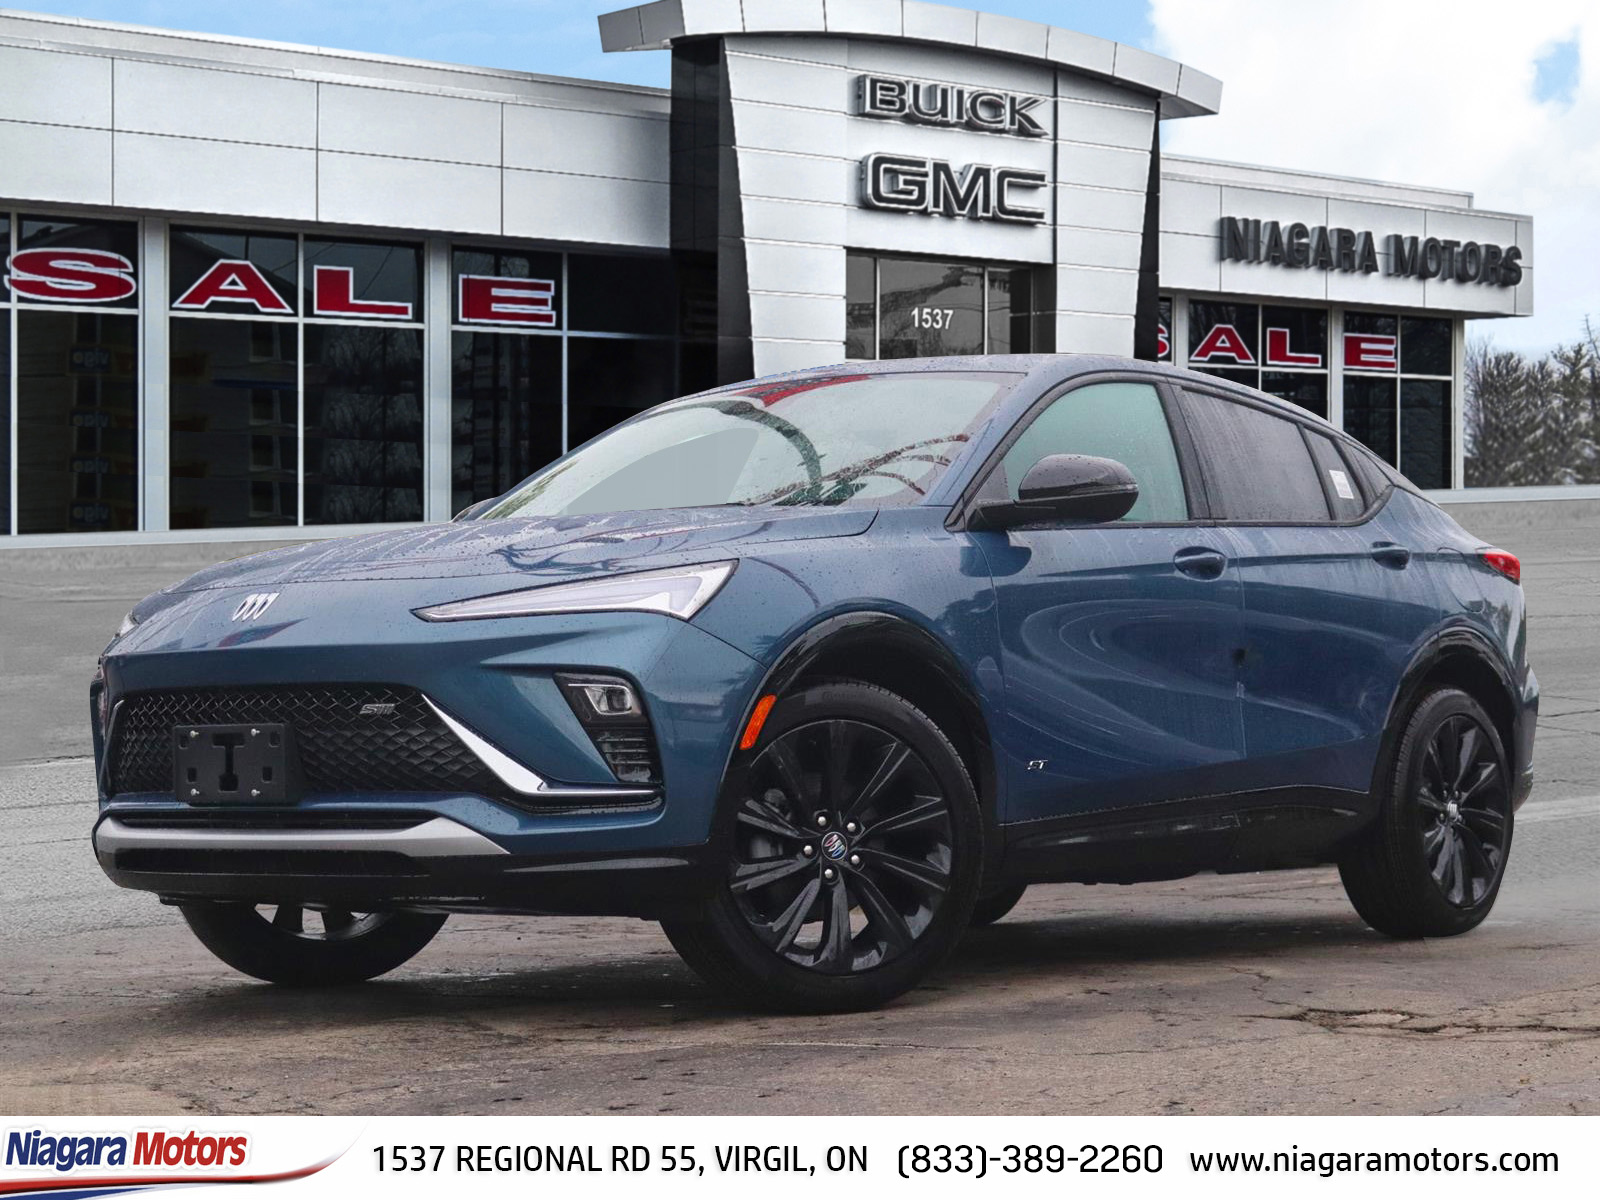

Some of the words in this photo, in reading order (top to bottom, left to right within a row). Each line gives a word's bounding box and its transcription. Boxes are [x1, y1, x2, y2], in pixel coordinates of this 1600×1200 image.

[857, 74, 1049, 136] BUICK
[861, 152, 1048, 225] GMC
[1220, 216, 1379, 273] NIAGARA
[1387, 234, 1523, 287] MOTORS
[4, 247, 557, 327] SALE
[910, 307, 954, 330] 1537
[1158, 323, 1397, 369] ALE
